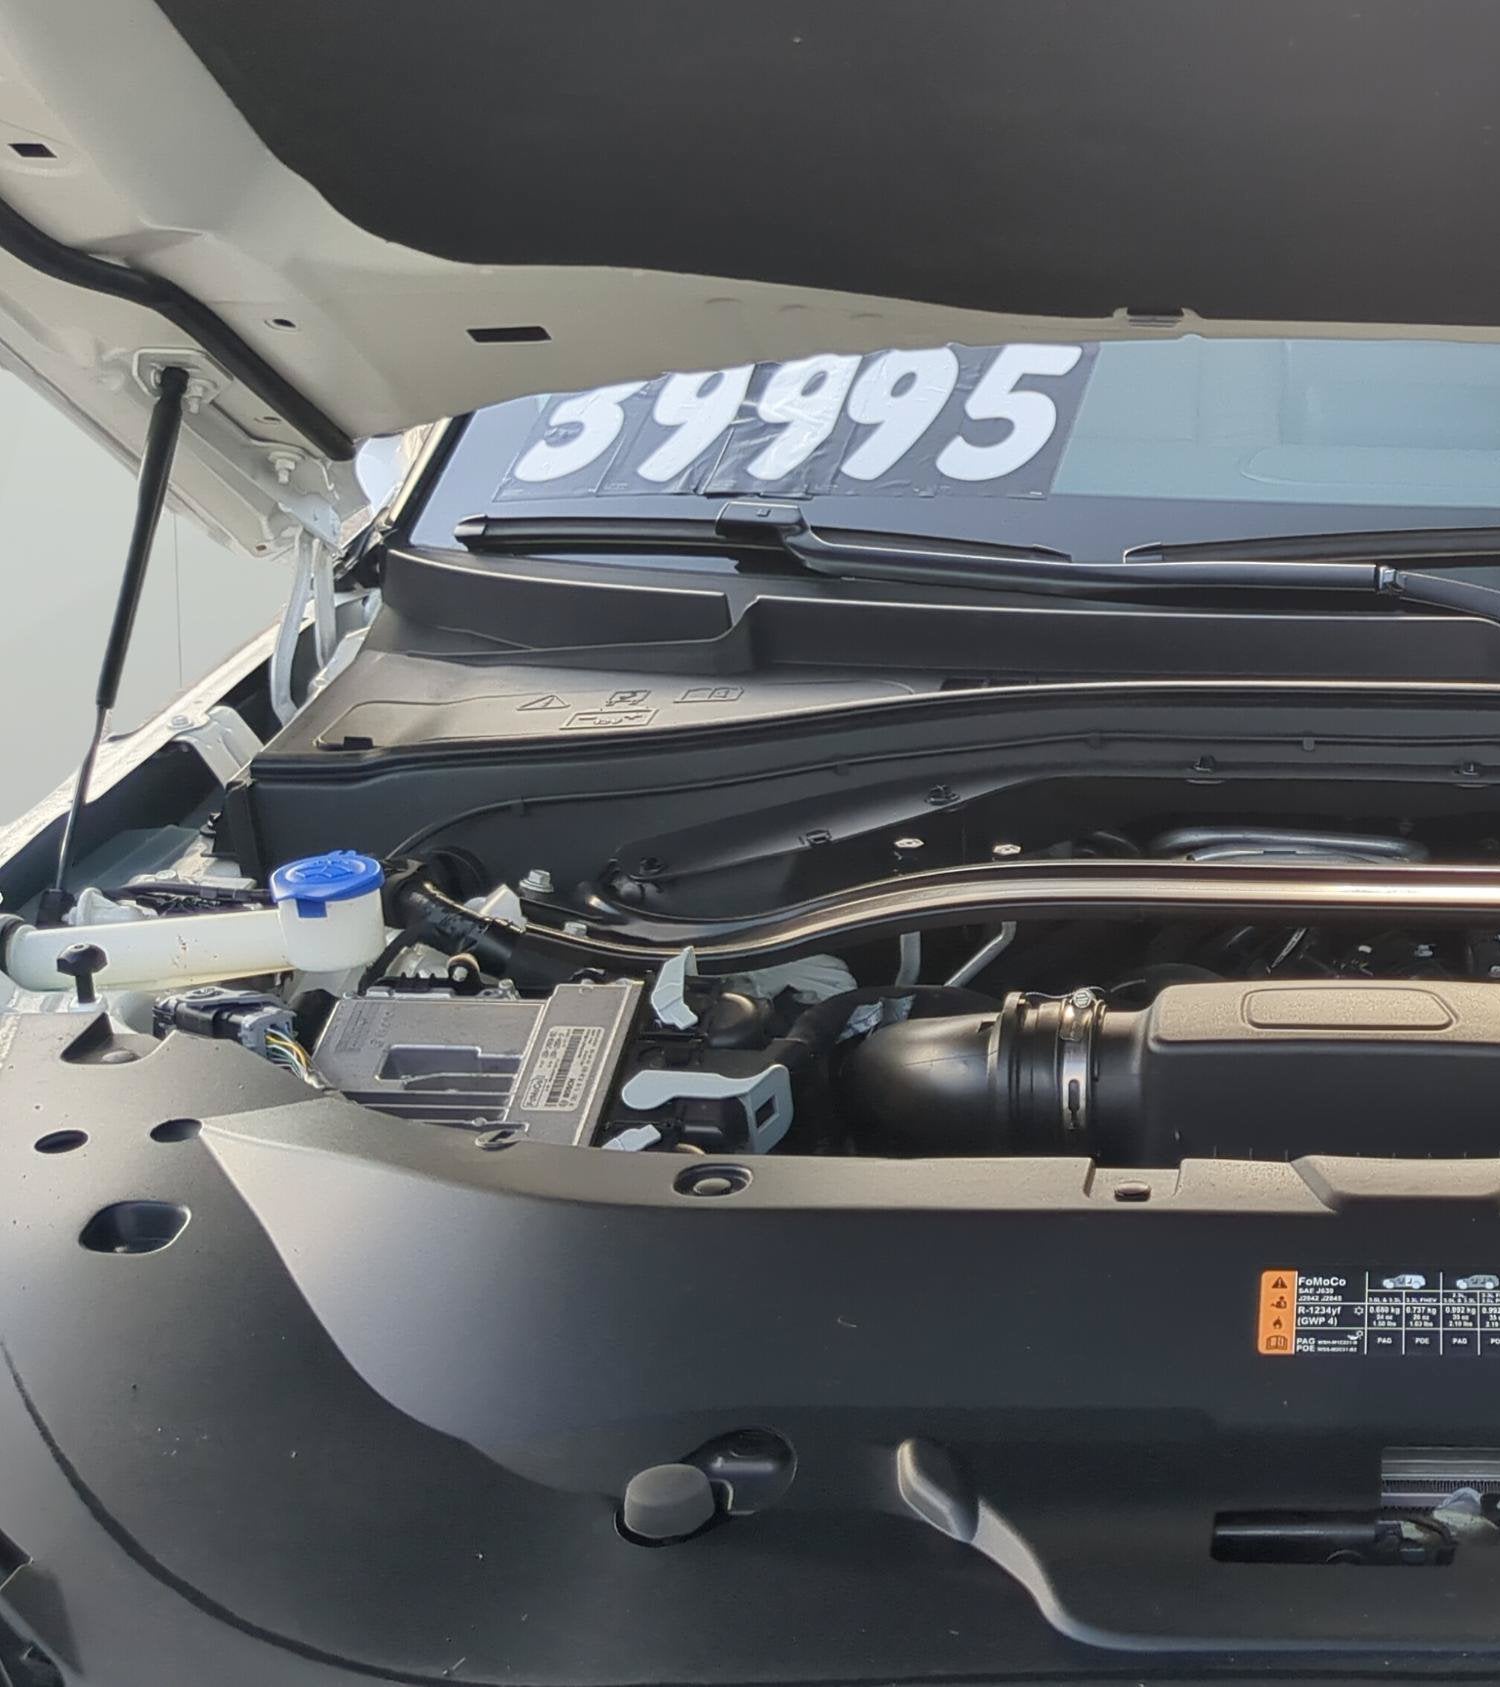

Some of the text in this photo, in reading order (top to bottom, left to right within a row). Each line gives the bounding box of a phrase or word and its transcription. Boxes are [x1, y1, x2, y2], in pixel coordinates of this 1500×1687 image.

[1298, 1277, 1346, 1286] FoMoCo
[1298, 1306, 1342, 1316] R-1234yf
[1391, 1306, 1400, 1315] kg
[1427, 1307, 1437, 1315] kg
[1466, 1307, 1476, 1315] kg
[1297, 1316, 1338, 1326] (GWP 4)
